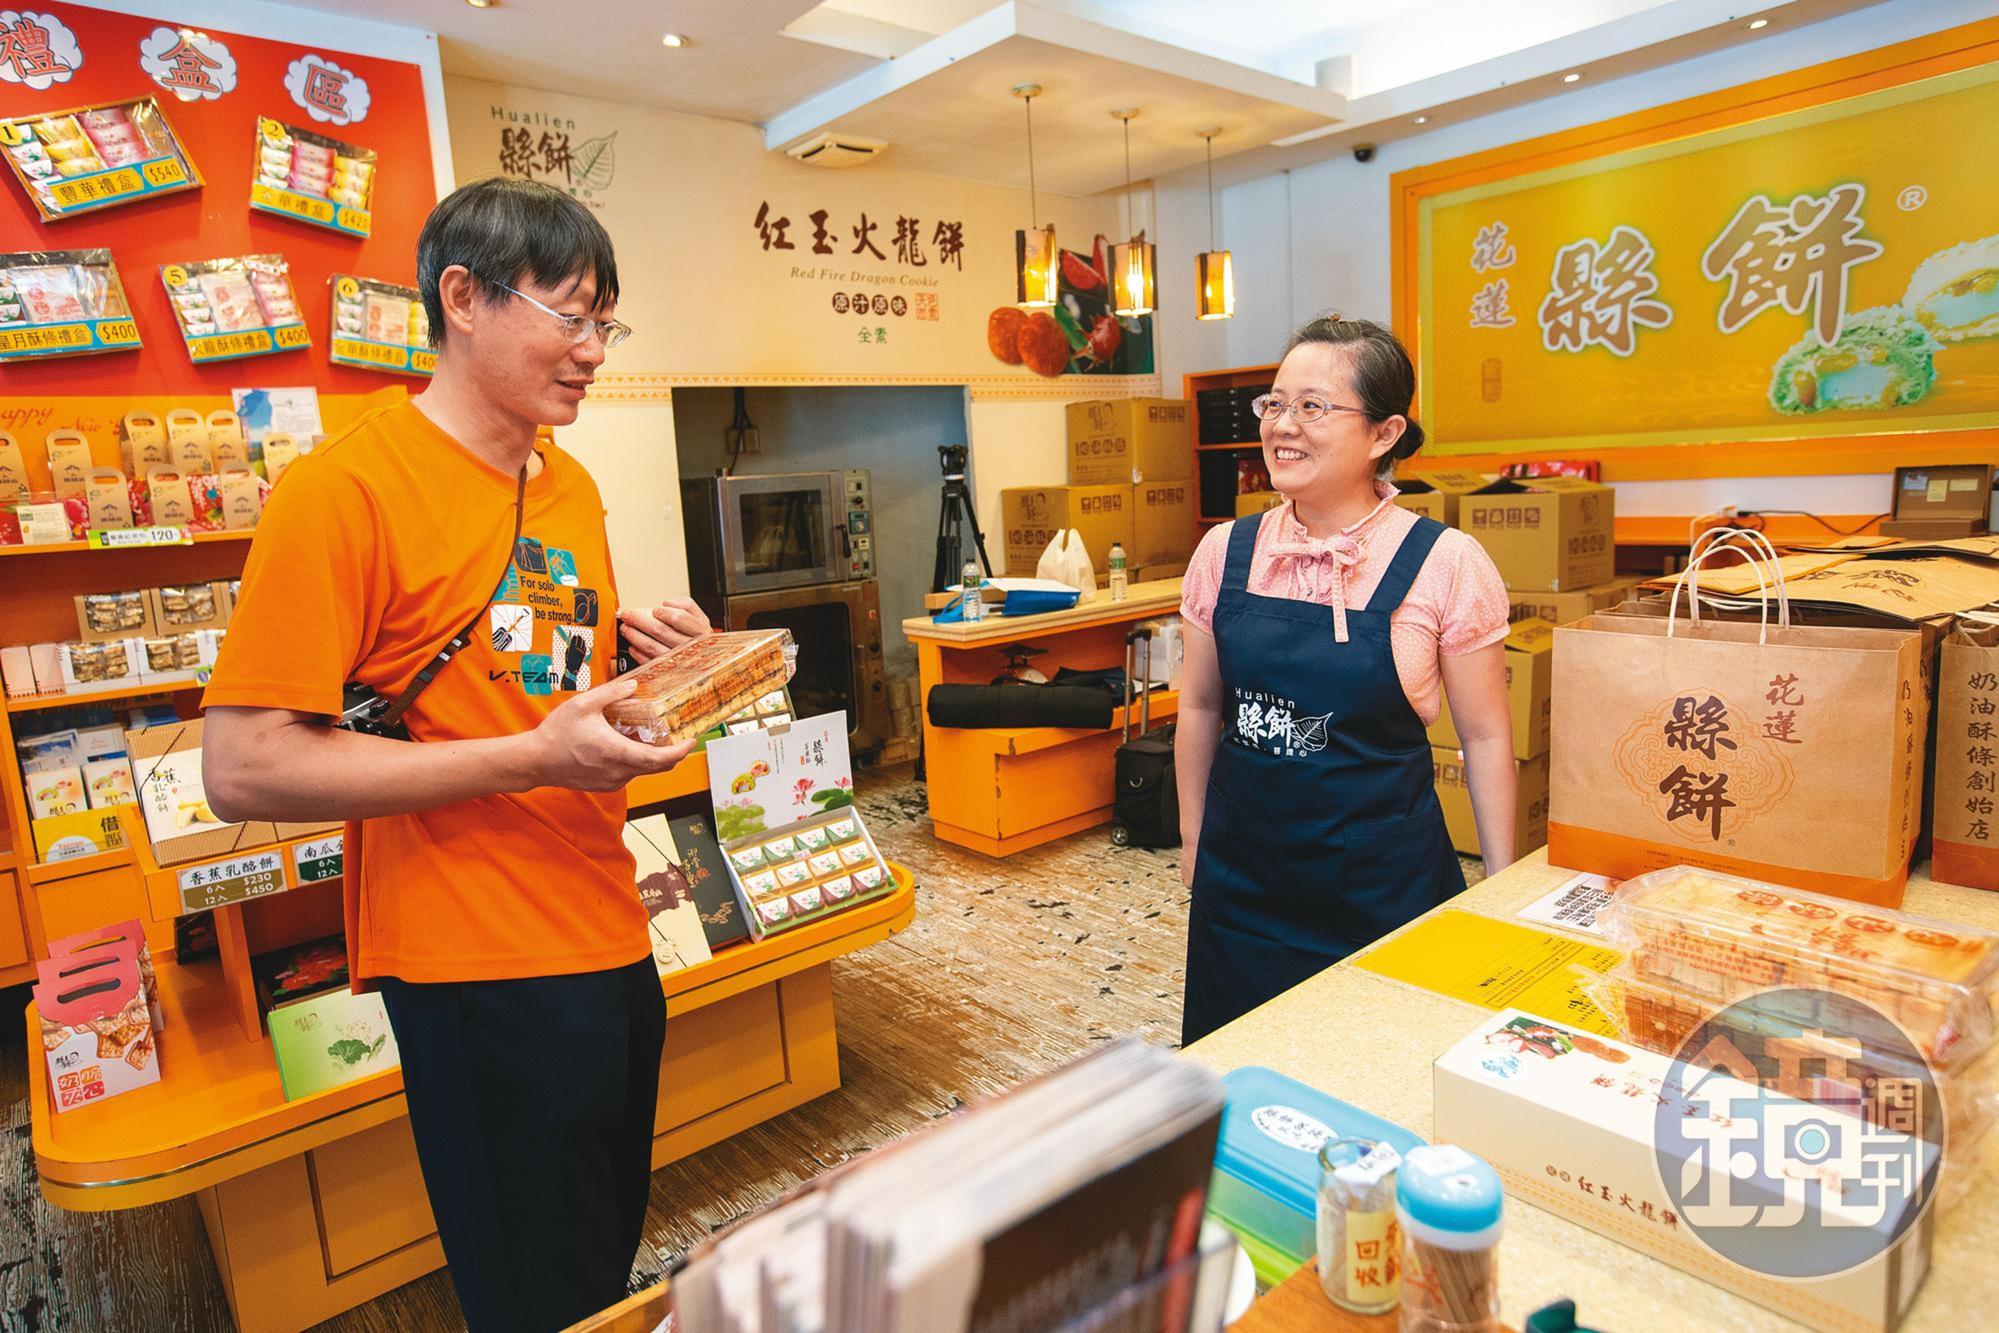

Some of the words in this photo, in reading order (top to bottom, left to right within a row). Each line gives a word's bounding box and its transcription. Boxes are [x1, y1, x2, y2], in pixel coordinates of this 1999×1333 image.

[491, 106, 576, 131] Hualien
[150, 164, 181, 184] $540
[790, 266, 815, 280] Red
[820, 268, 846, 281] Fire
[850, 271, 896, 287] Dragon
[899, 274, 939, 288] Cookie
[1470, 222, 1516, 329] 花蓮
[102, 324, 137, 341] $400
[280, 330, 309, 346] $400
[520, 575, 535, 589] For
[538, 579, 555, 592] solo
[535, 606, 546, 620] be
[1234, 687, 1296, 710] Hualien
[1762, 673, 1805, 744] 花蓮
[1965, 671, 1998, 841] 奶油酥條創始店
[190, 856, 274, 885] 香蕉乳酪餅
[243, 872, 272, 886] $230
[245, 883, 274, 896] $450
